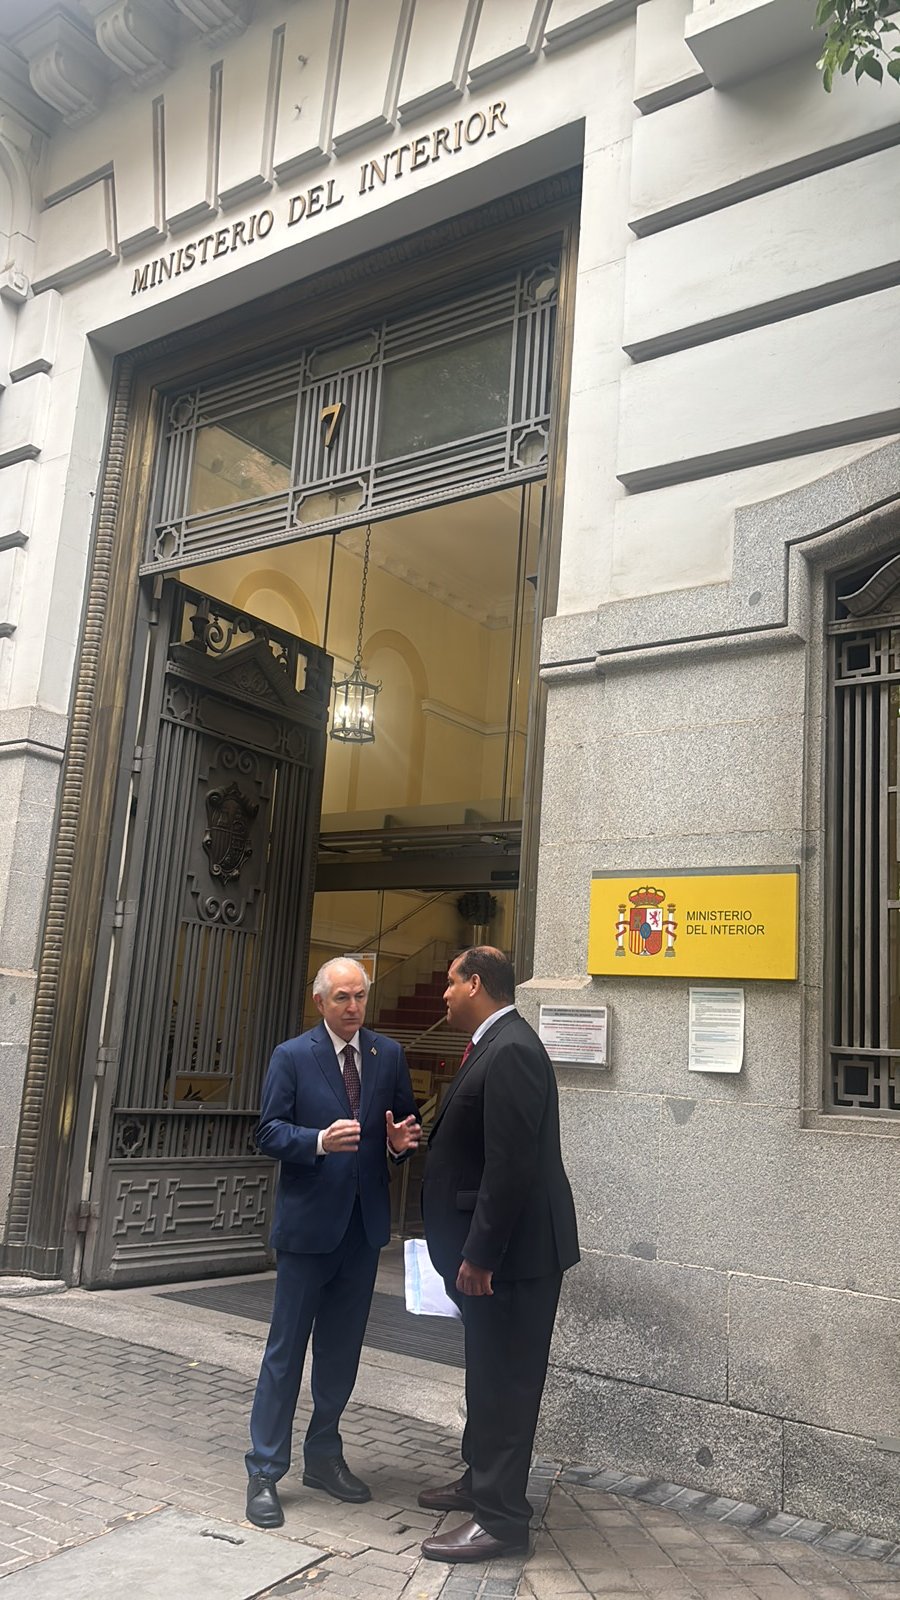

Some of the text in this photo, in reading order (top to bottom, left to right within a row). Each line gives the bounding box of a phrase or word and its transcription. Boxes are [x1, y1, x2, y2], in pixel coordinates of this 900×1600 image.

[131, 100, 509, 296] MINISTERIO DEL INTERIOR
[320, 402, 345, 449] 7
[686, 910, 753, 921] MINISTERIO
[686, 925, 765, 935] DEL INTERIOR
